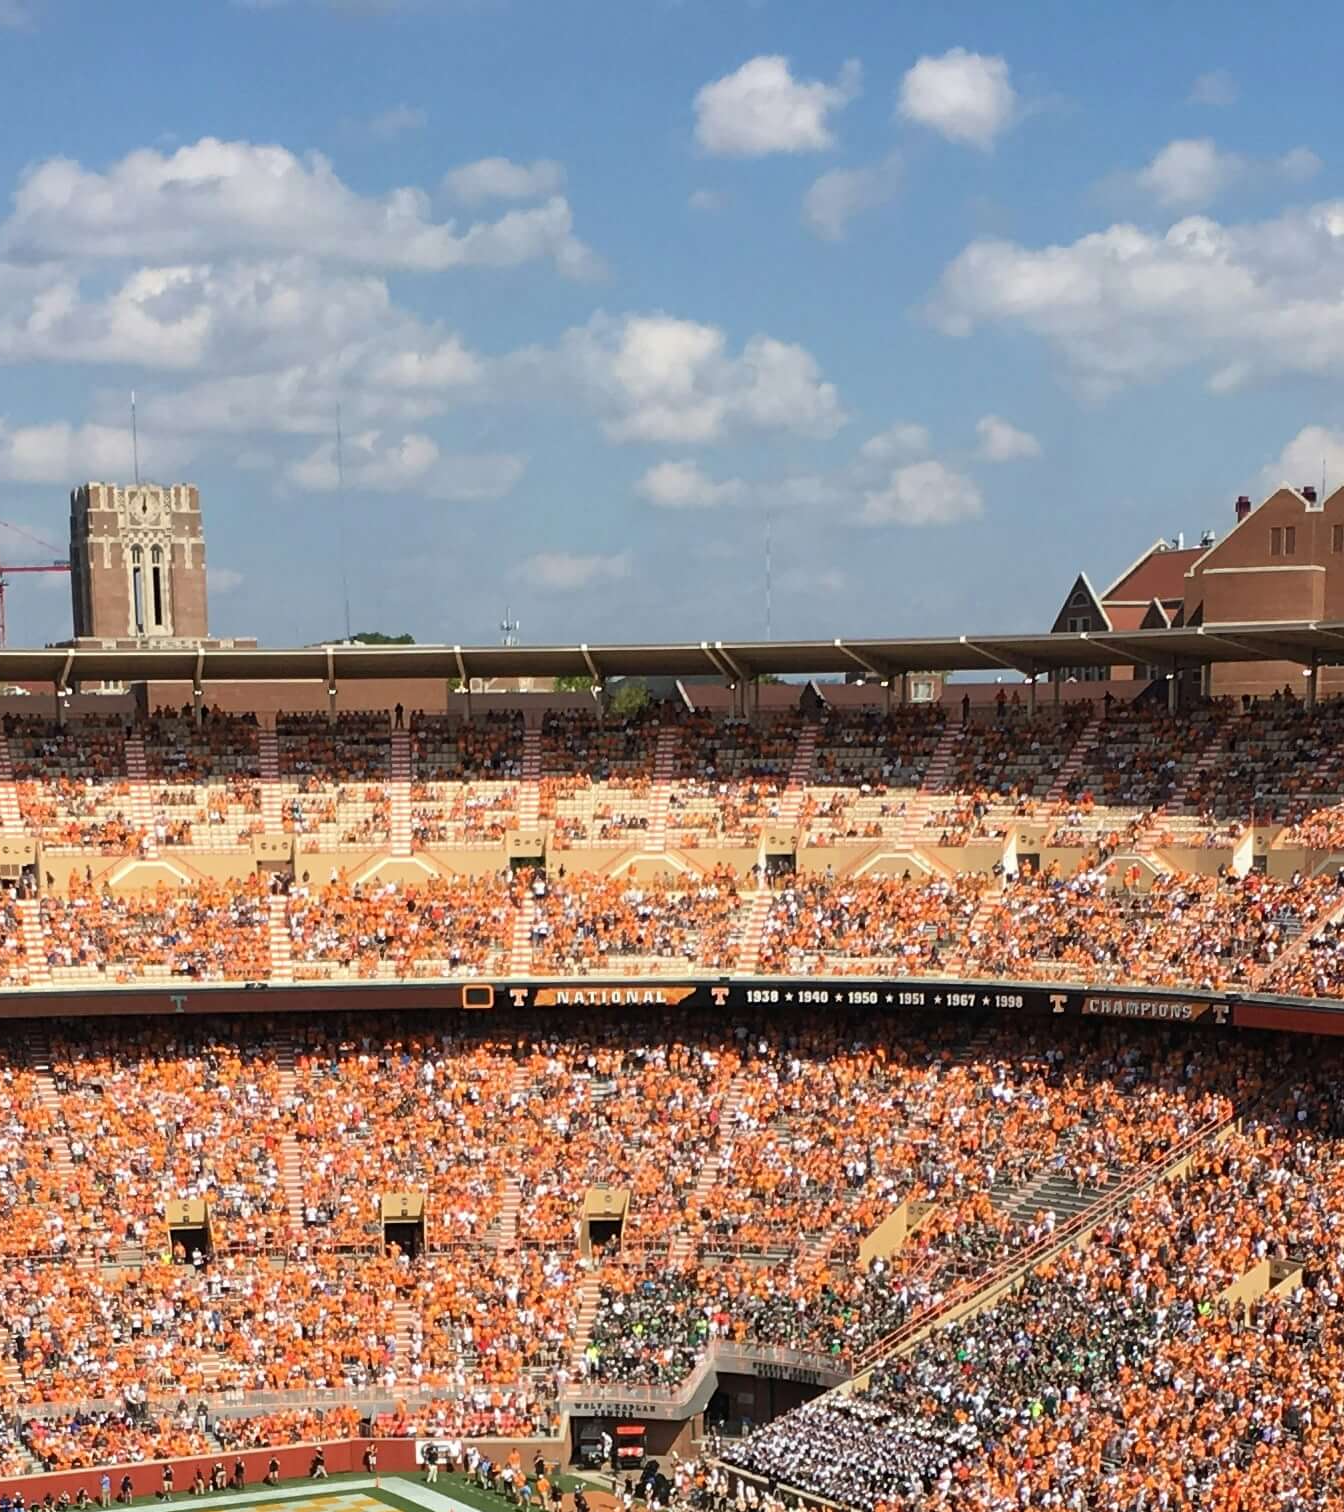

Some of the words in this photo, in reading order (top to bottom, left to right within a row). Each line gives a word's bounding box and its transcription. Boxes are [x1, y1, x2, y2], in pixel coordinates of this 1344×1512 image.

[557, 990, 668, 1005] NATIONAL
[711, 987, 730, 1005] T
[797, 990, 829, 1004] 1940
[847, 991, 878, 1005] 1950
[899, 992, 925, 1006] 1951
[946, 993, 976, 1007] 1967
[995, 995, 1024, 1008] 1998
[1049, 994, 1068, 1013] T
[1088, 998, 1193, 1019] CHAMPIONS
[1213, 1004, 1230, 1024] T
